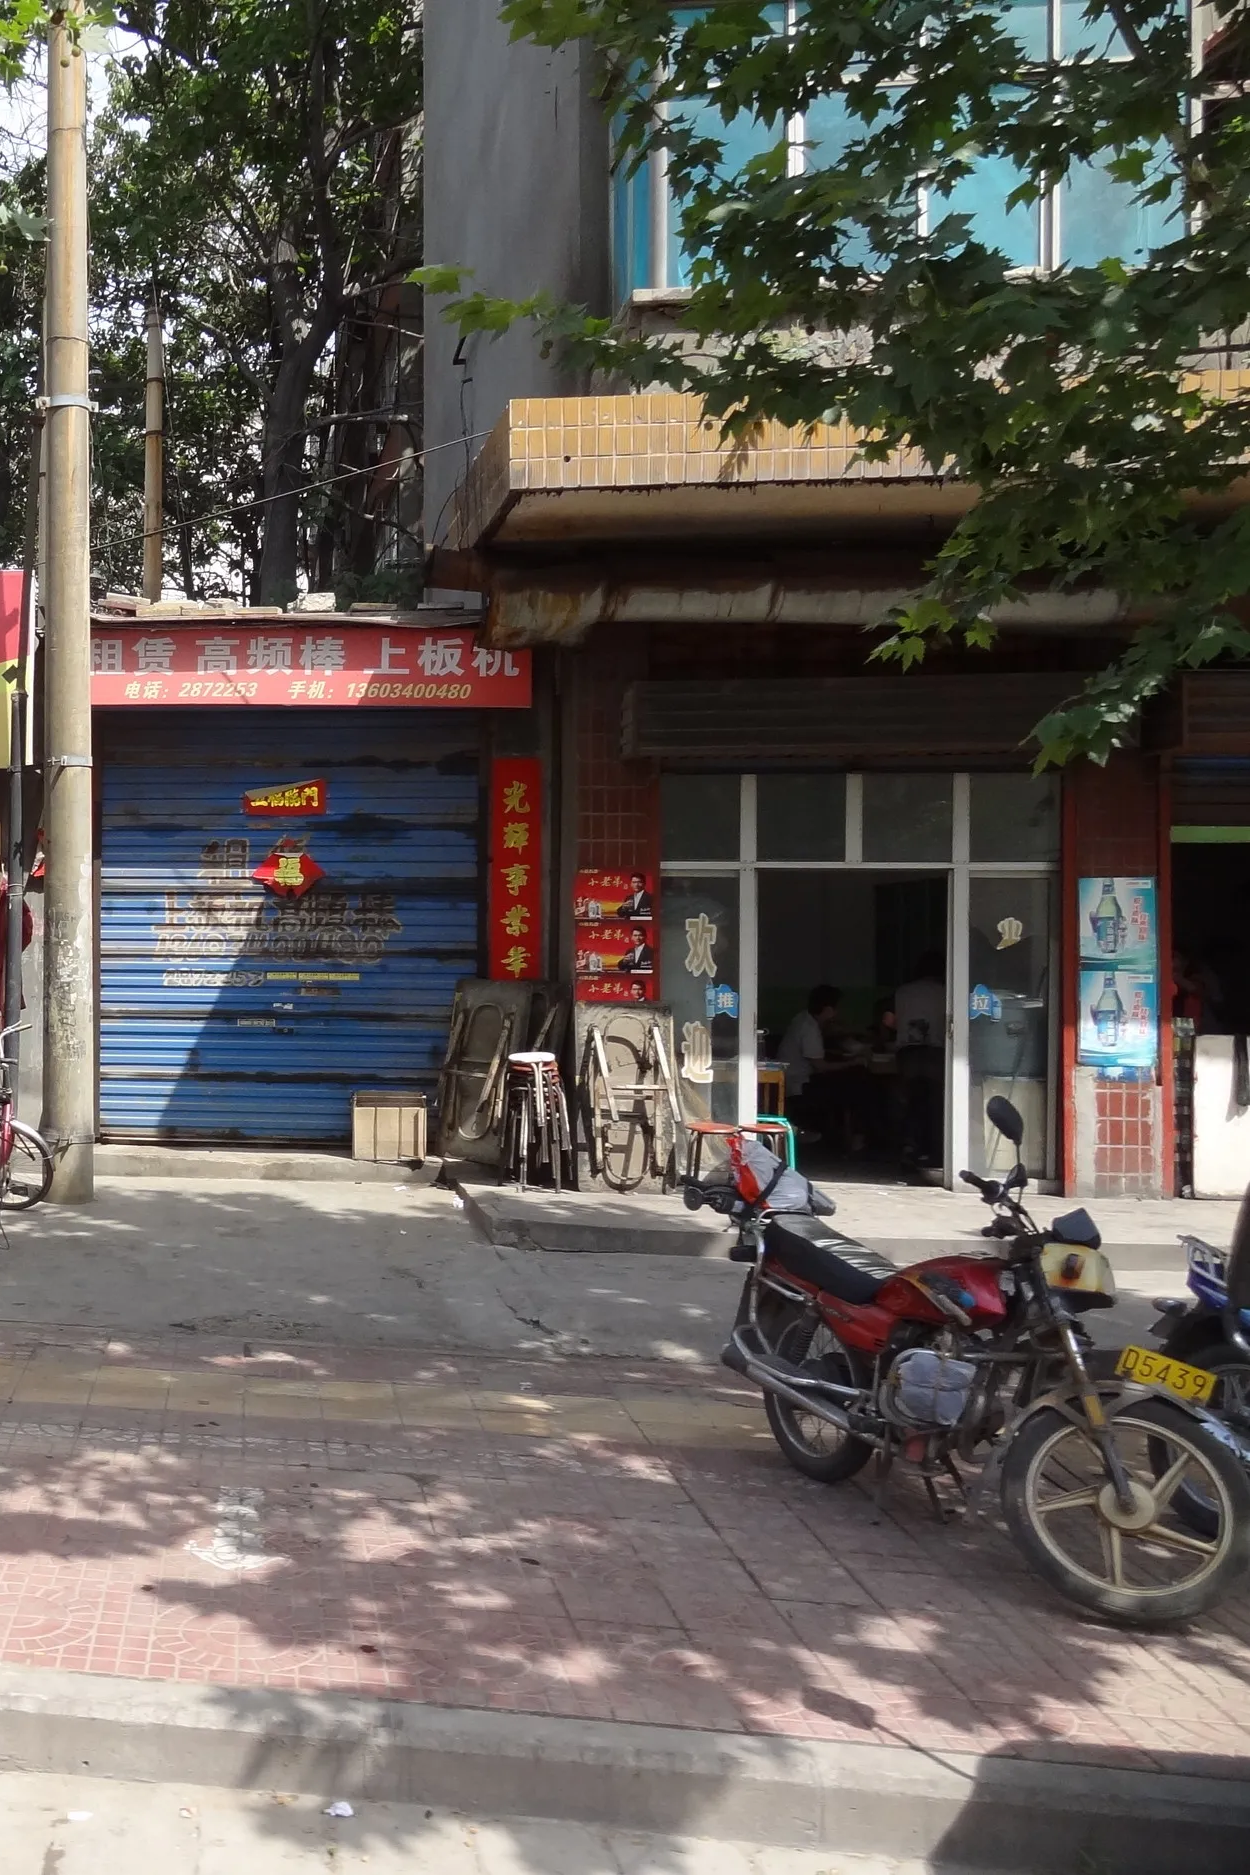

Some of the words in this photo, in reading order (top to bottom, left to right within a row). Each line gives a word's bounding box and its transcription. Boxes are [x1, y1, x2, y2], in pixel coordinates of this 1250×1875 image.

[90, 637, 177, 676] 租赁
[195, 636, 346, 676] 高频棒
[363, 636, 520, 677] 上板机
[716, 992, 734, 1009] 推
[971, 994, 990, 1010] 拉
[1122, 1348, 1207, 1396] D5439
